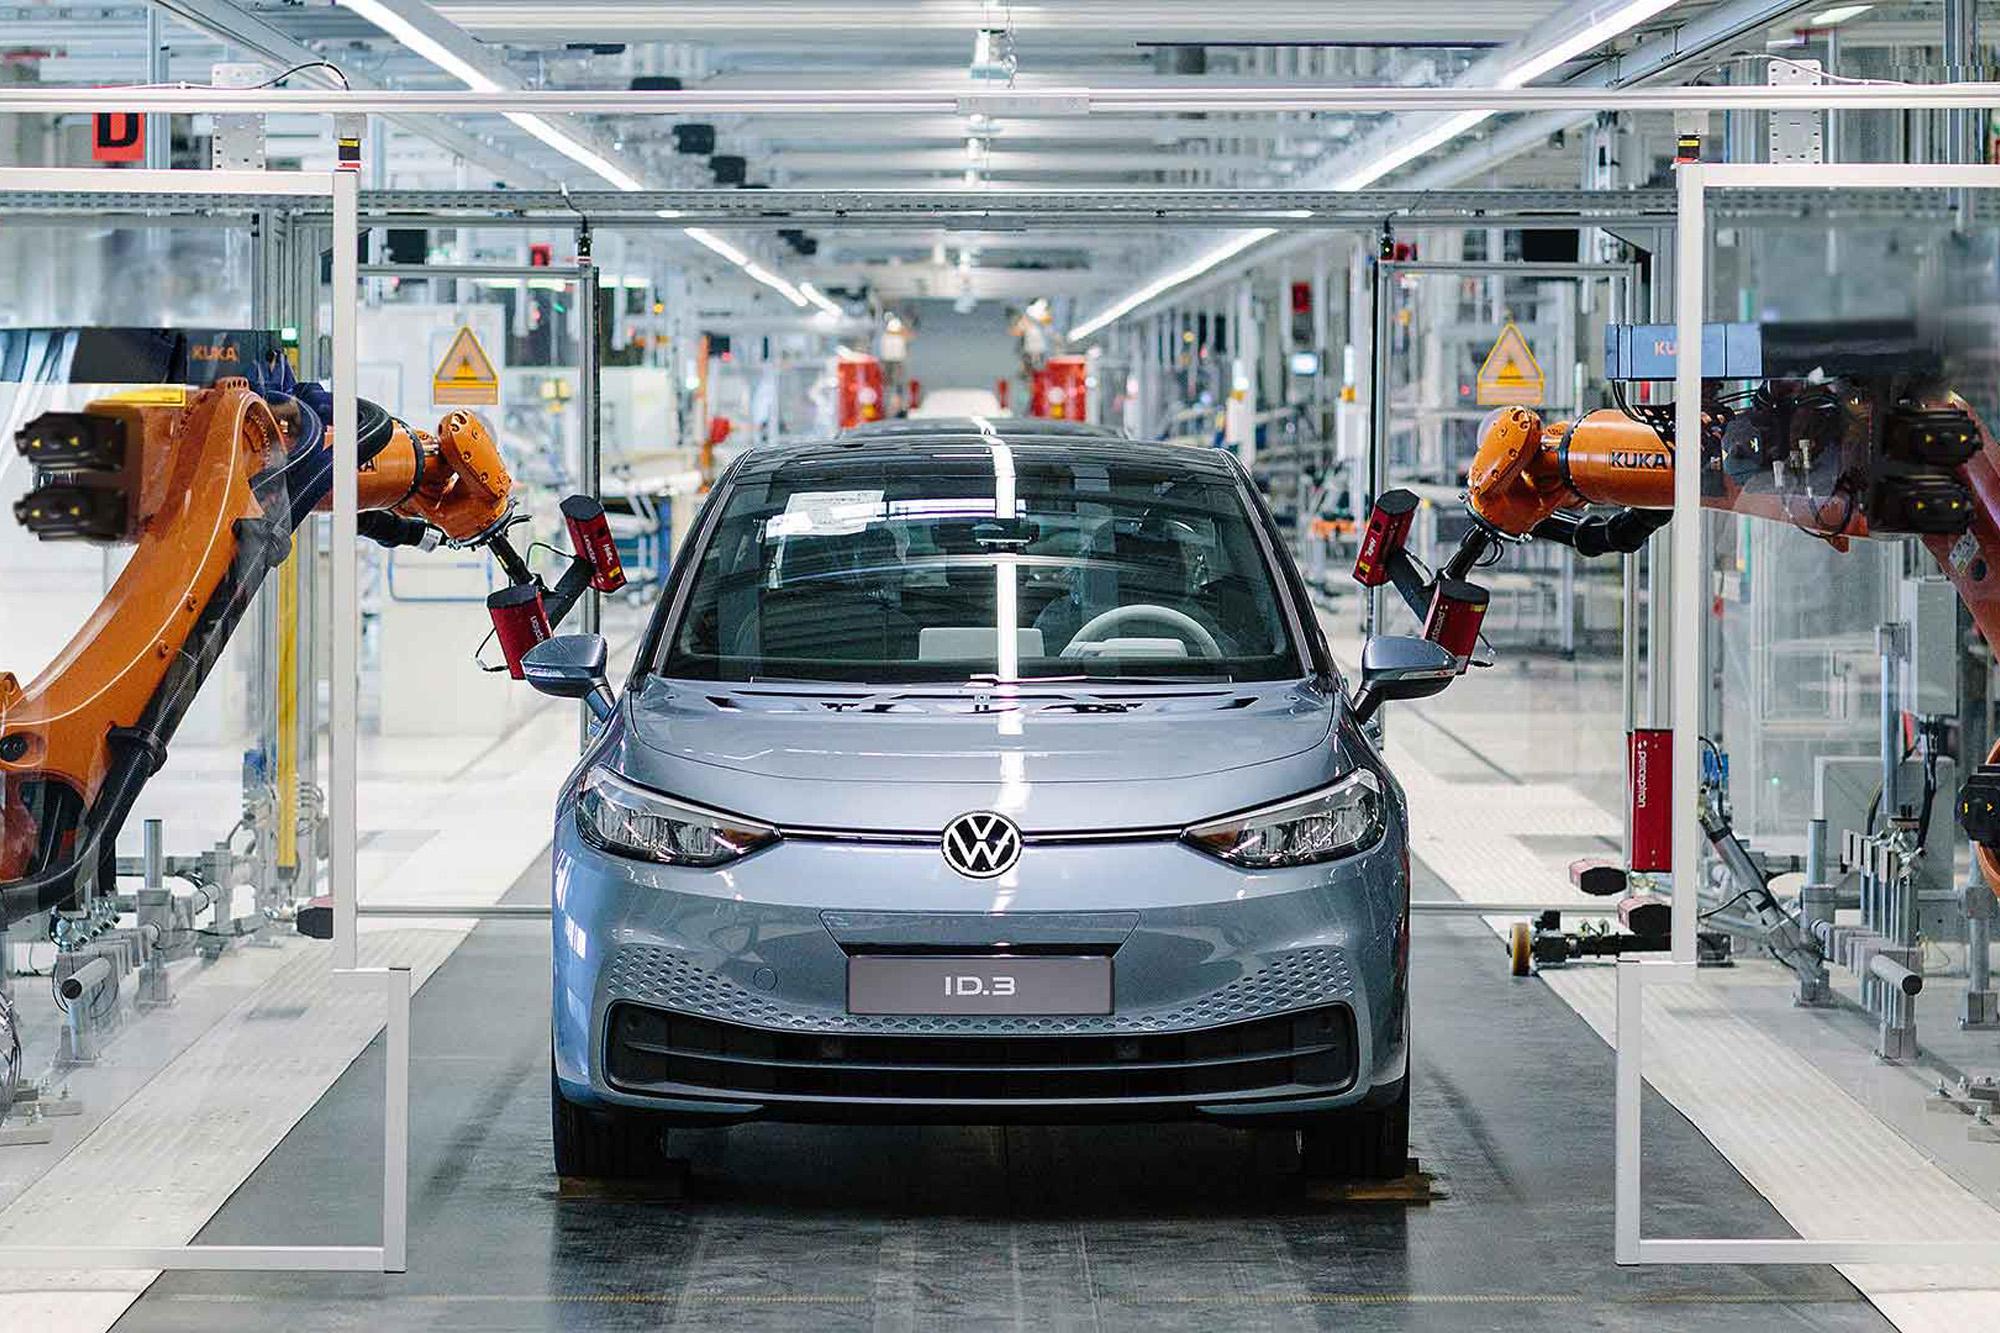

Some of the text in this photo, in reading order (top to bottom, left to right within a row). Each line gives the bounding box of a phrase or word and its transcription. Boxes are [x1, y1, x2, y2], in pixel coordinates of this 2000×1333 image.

[191, 344, 239, 361] KUKA
[1655, 341, 1679, 356] KU
[1611, 451, 1668, 470] KUKA
[943, 812, 1020, 876] VW
[945, 976, 1016, 996] ID.3
